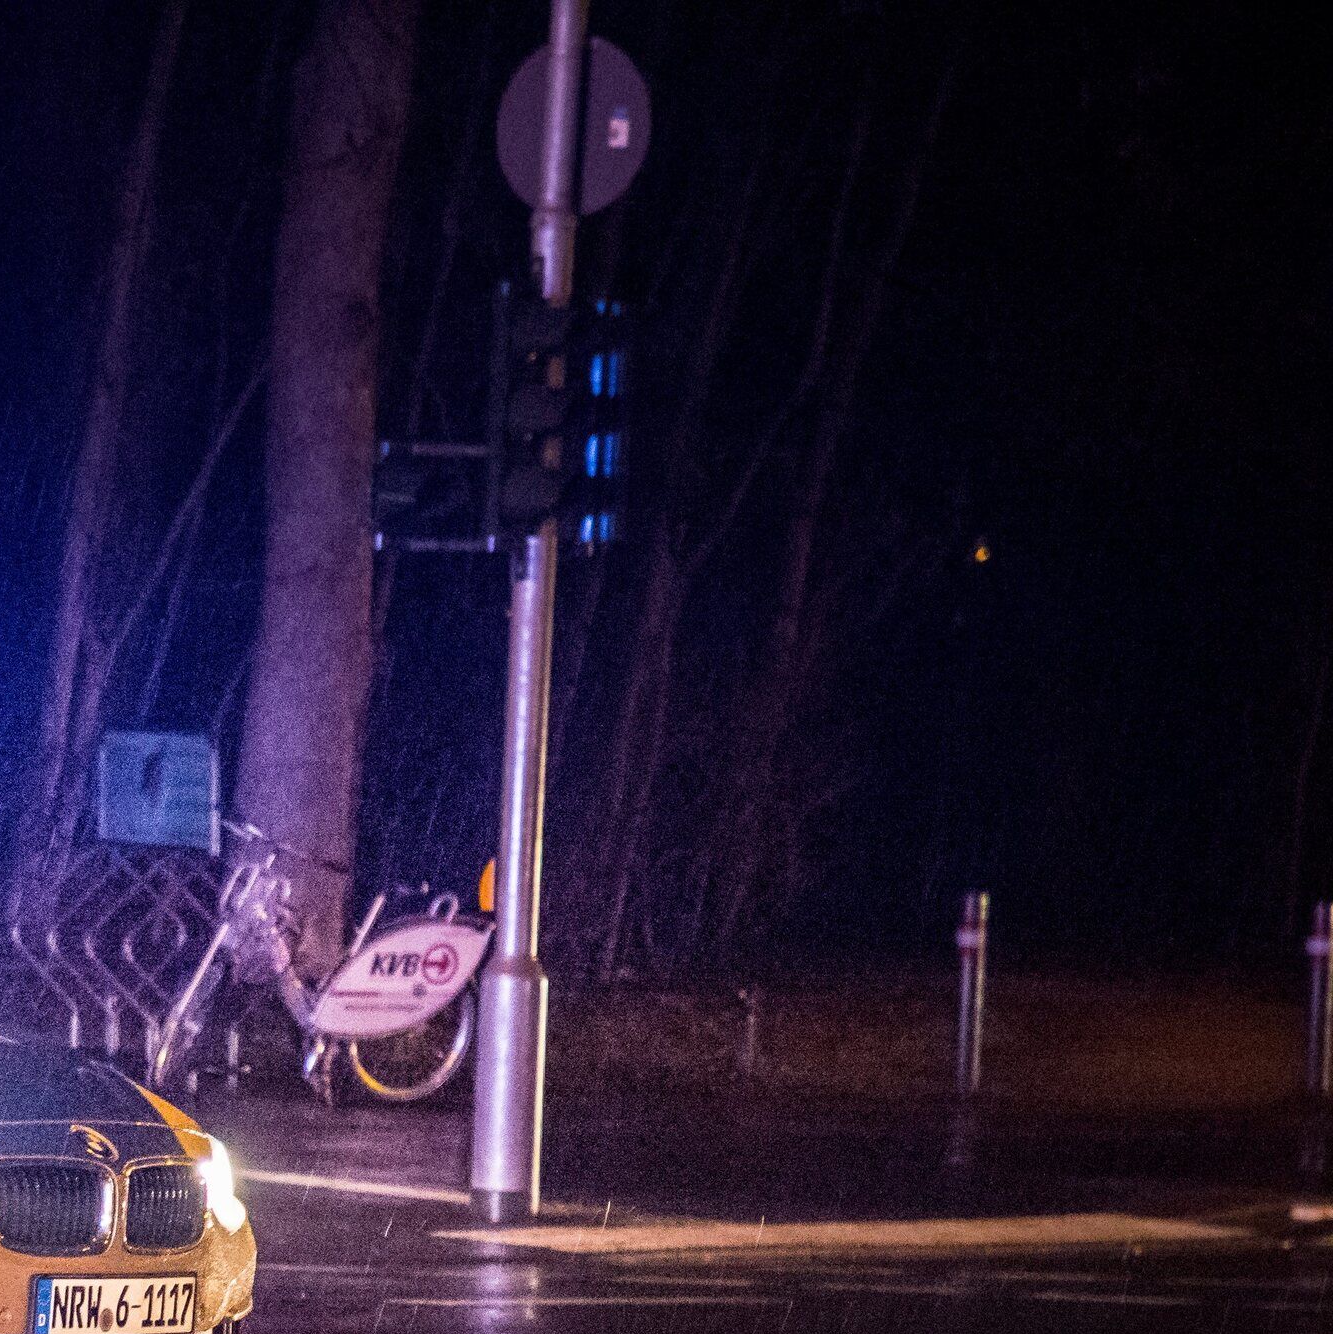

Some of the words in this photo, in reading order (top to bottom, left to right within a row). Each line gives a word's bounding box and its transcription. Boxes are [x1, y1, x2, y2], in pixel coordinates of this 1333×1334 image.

[370, 951, 420, 976] KVB
[51, 1285, 102, 1329] NRW
[115, 1283, 194, 1328] 6-1117
[38, 1313, 46, 1327] D
